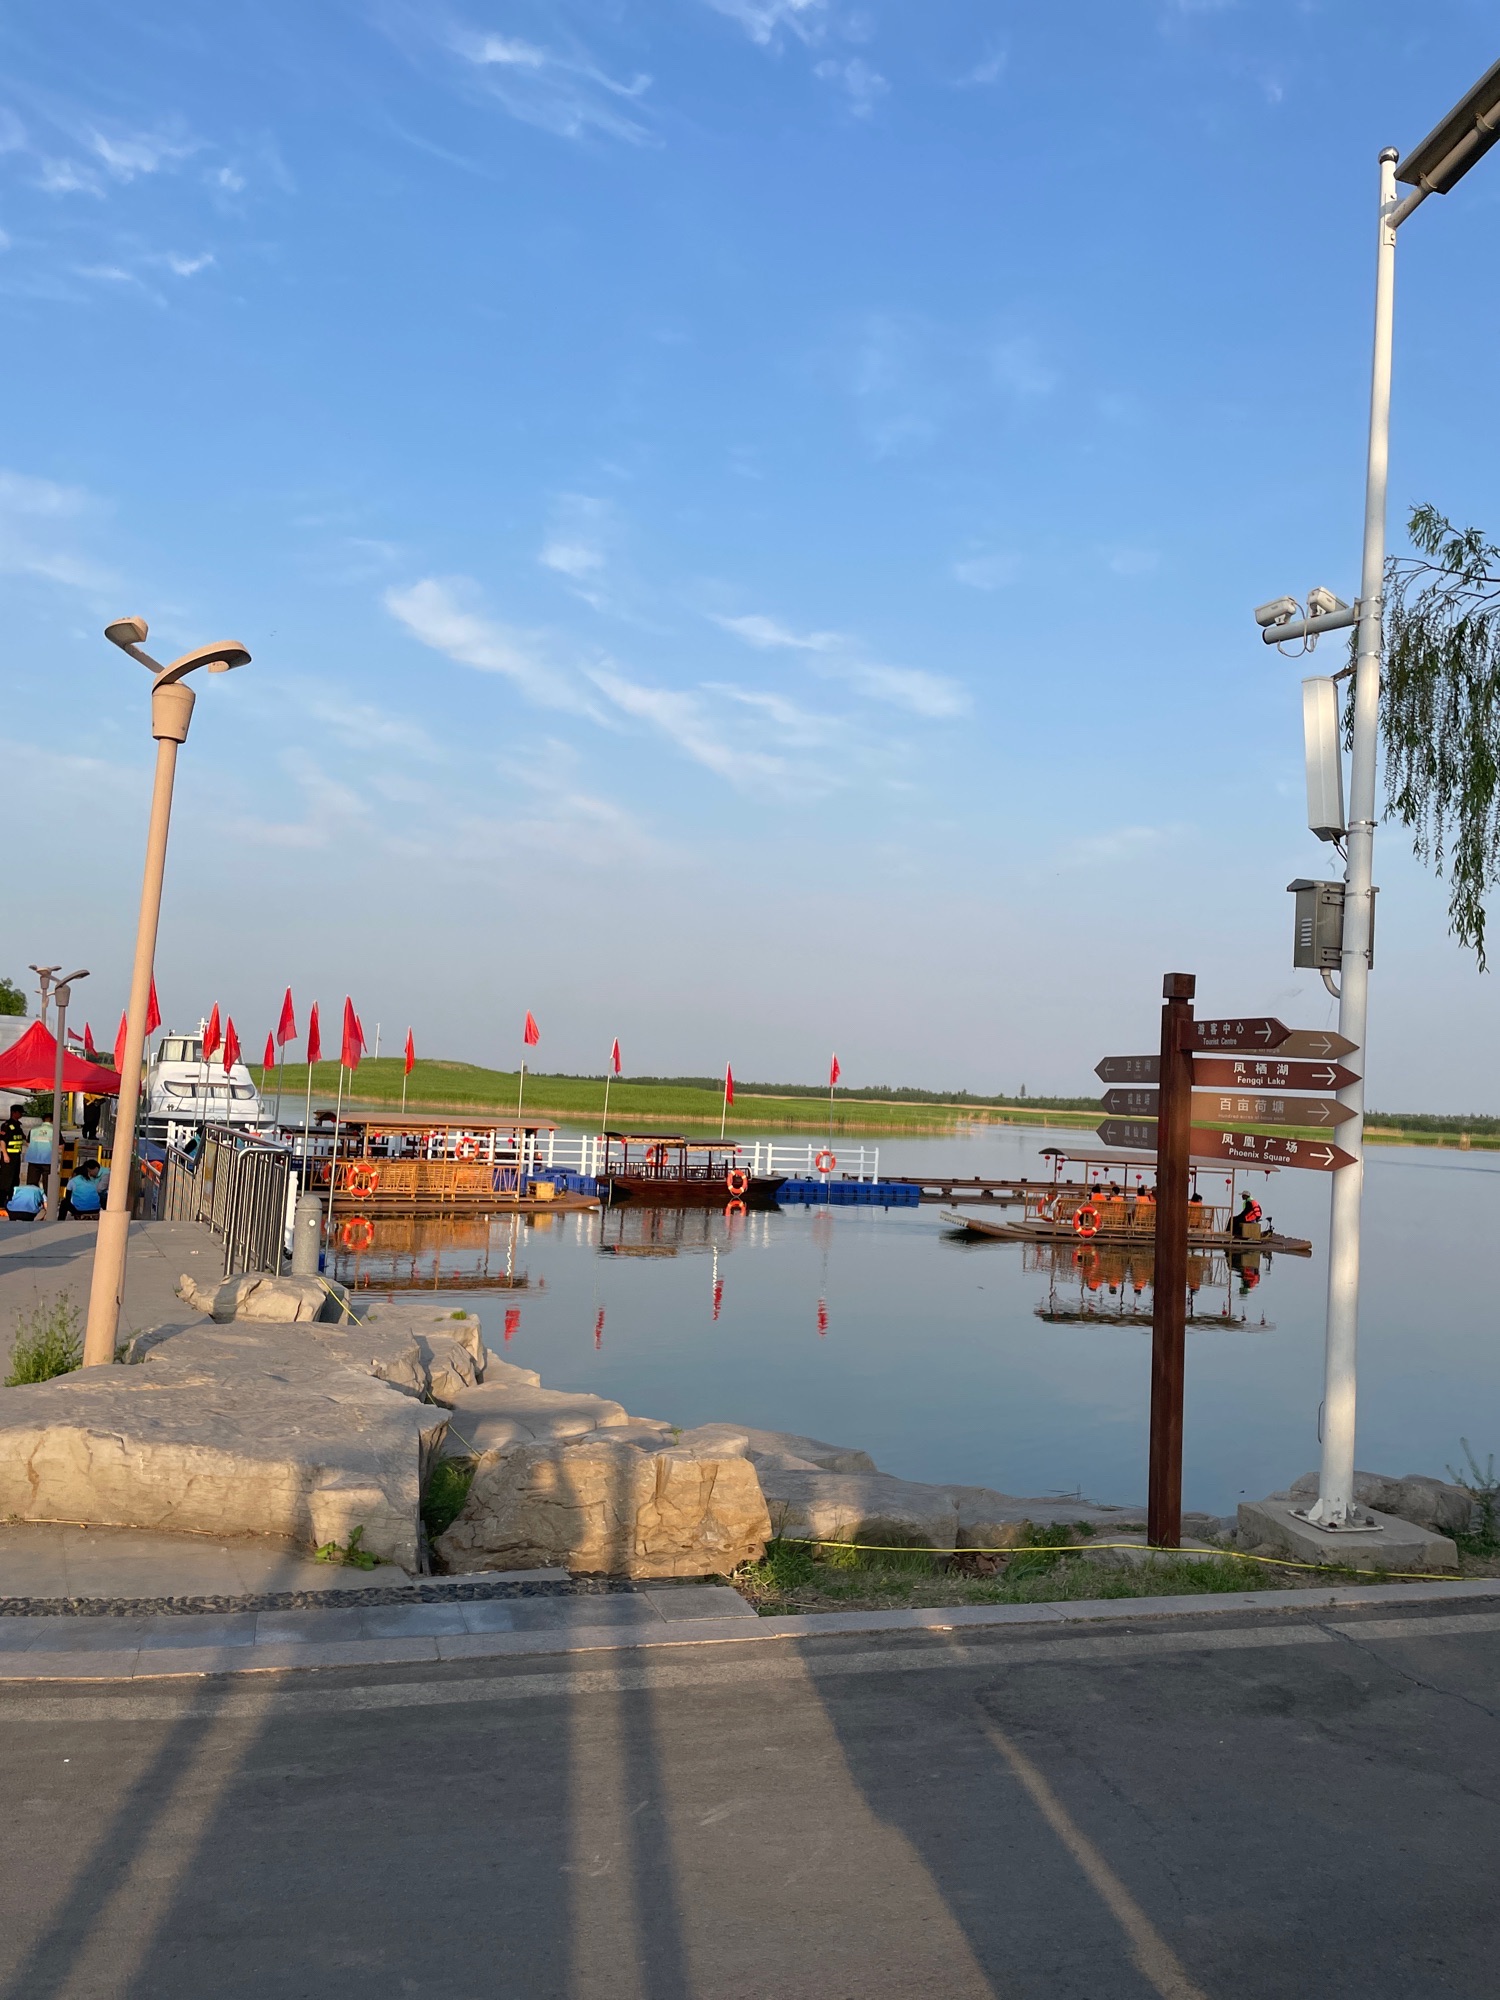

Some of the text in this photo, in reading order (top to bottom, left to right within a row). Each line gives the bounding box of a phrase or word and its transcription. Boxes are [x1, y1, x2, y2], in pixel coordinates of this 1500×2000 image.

[1198, 1022, 1244, 1035] 游客中心
[1203, 1037, 1237, 1045] Tourist Centre
[1233, 1062, 1289, 1076] 凤栖湖
[1237, 1076, 1286, 1085] Fengqi Lake
[1219, 1097, 1285, 1113] 百亩荷塘
[1222, 1133, 1298, 1153] 凤凰广场
[1229, 1148, 1291, 1162] Phoenix Square
